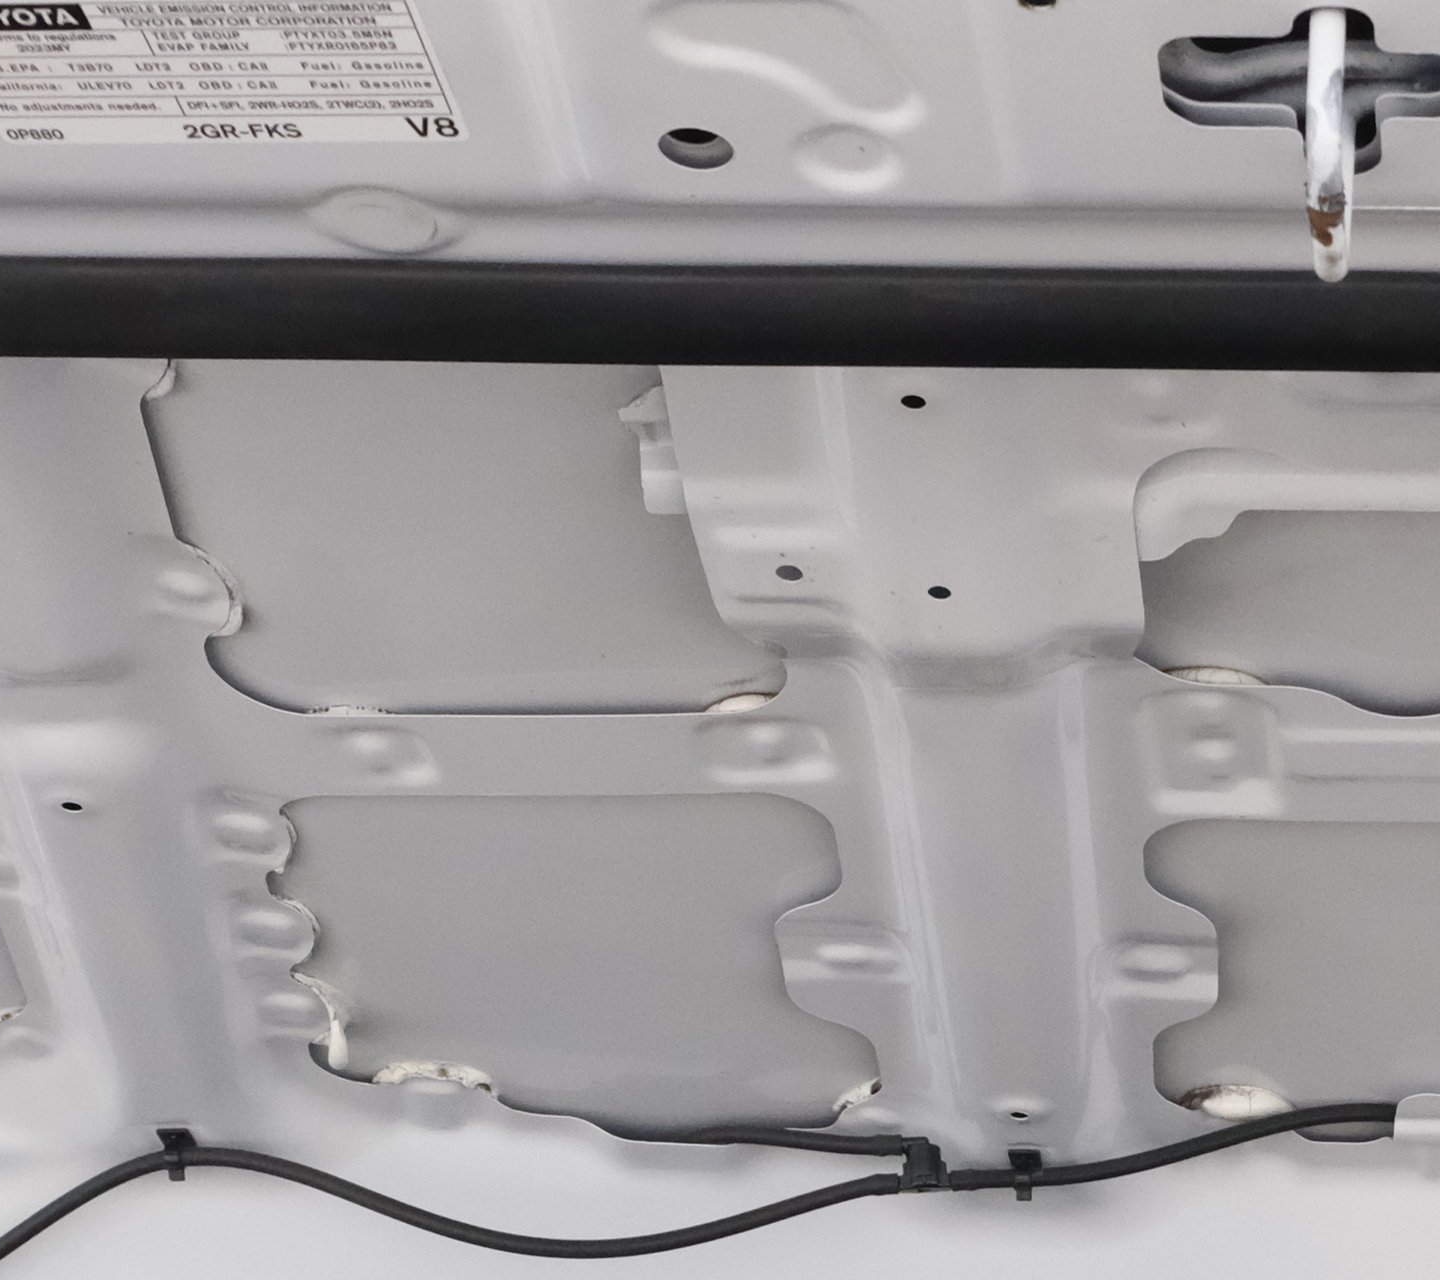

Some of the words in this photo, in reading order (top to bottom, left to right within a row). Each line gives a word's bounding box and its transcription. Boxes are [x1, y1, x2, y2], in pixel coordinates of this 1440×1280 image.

[96, 5, 155, 14] VEHICLE
[159, 4, 225, 14] EMISSION
[229, 3, 294, 13] CONTROL
[298, 3, 392, 12] INFORMATION
[121, 18, 185, 27] TOYOTA
[189, 16, 251, 26] MOTOR
[255, 15, 377, 26] CORPORATION
[27, 32, 40, 42] to
[154, 31, 185, 40] TEST
[191, 31, 241, 40] GROUP
[157, 43, 195, 52] EVAP
[200, 42, 250, 51] FAMILY
[189, 62, 224, 72] OBD
[351, 61, 424, 71] Gasoline
[77, 81, 133, 91] ULEV70
[149, 81, 186, 91] LDT2
[198, 80, 234, 90] OBD
[359, 79, 432, 89] Gasoline
[0, 103, 18, 112] No
[22, 102, 104, 113] adjustments
[183, 123, 303, 139] 2GR-FKS
[405, 116, 460, 138] V8
